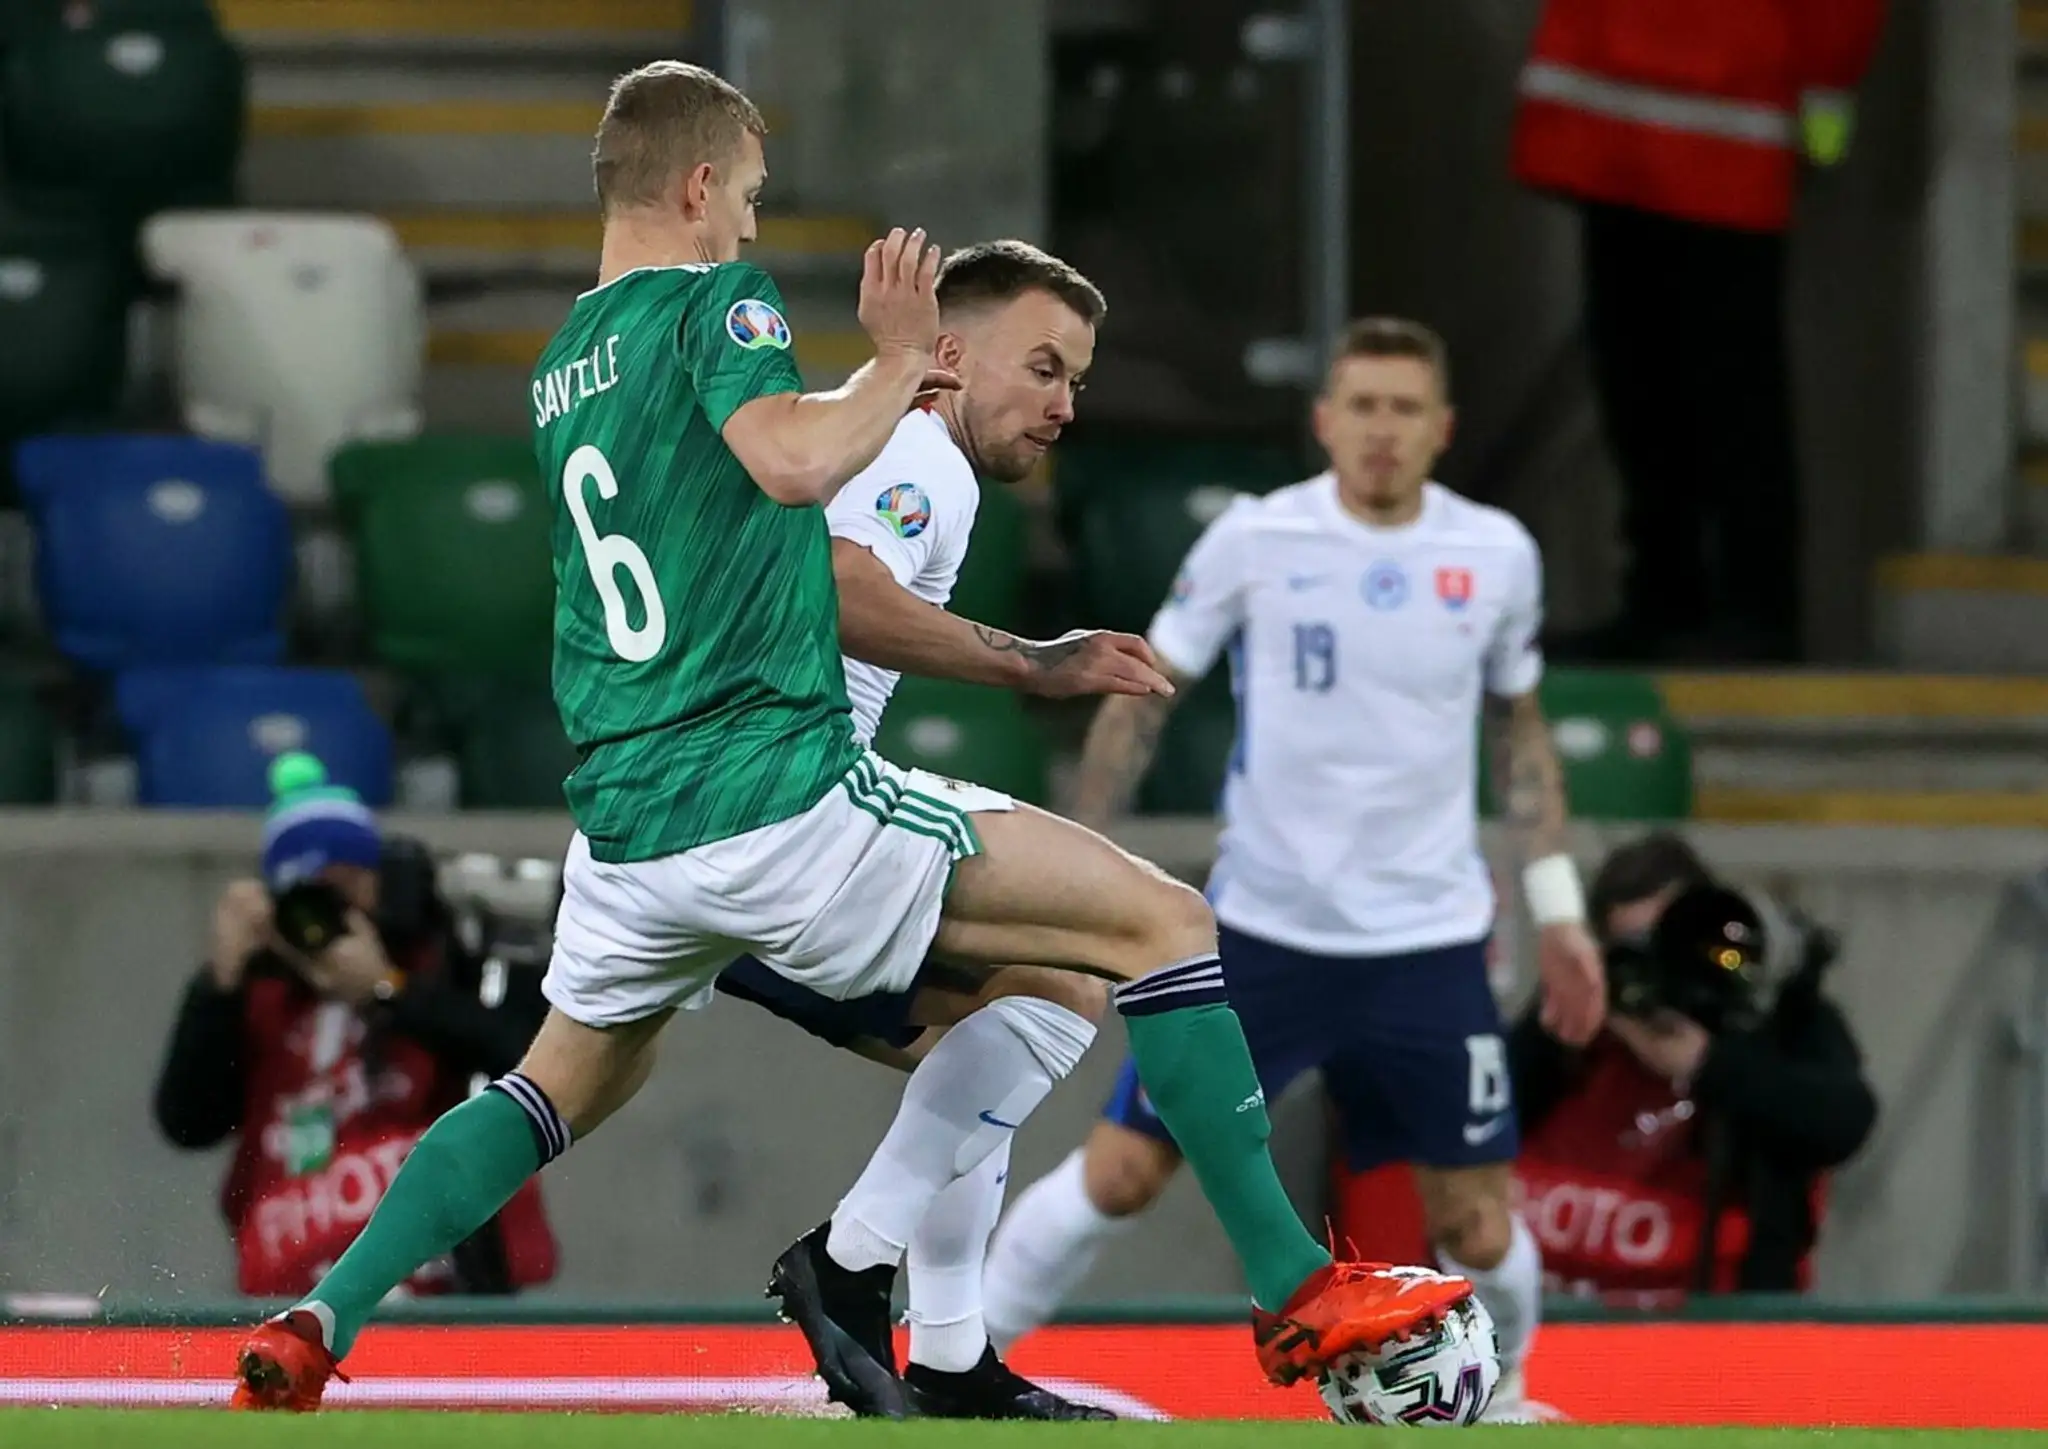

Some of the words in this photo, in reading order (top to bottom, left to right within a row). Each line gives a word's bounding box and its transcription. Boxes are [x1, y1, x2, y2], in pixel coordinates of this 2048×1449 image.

[562, 444, 667, 663] 6
[1293, 622, 1337, 693] 19
[257, 1133, 424, 1263] PHOT
[1509, 1178, 1673, 1264] OTO
